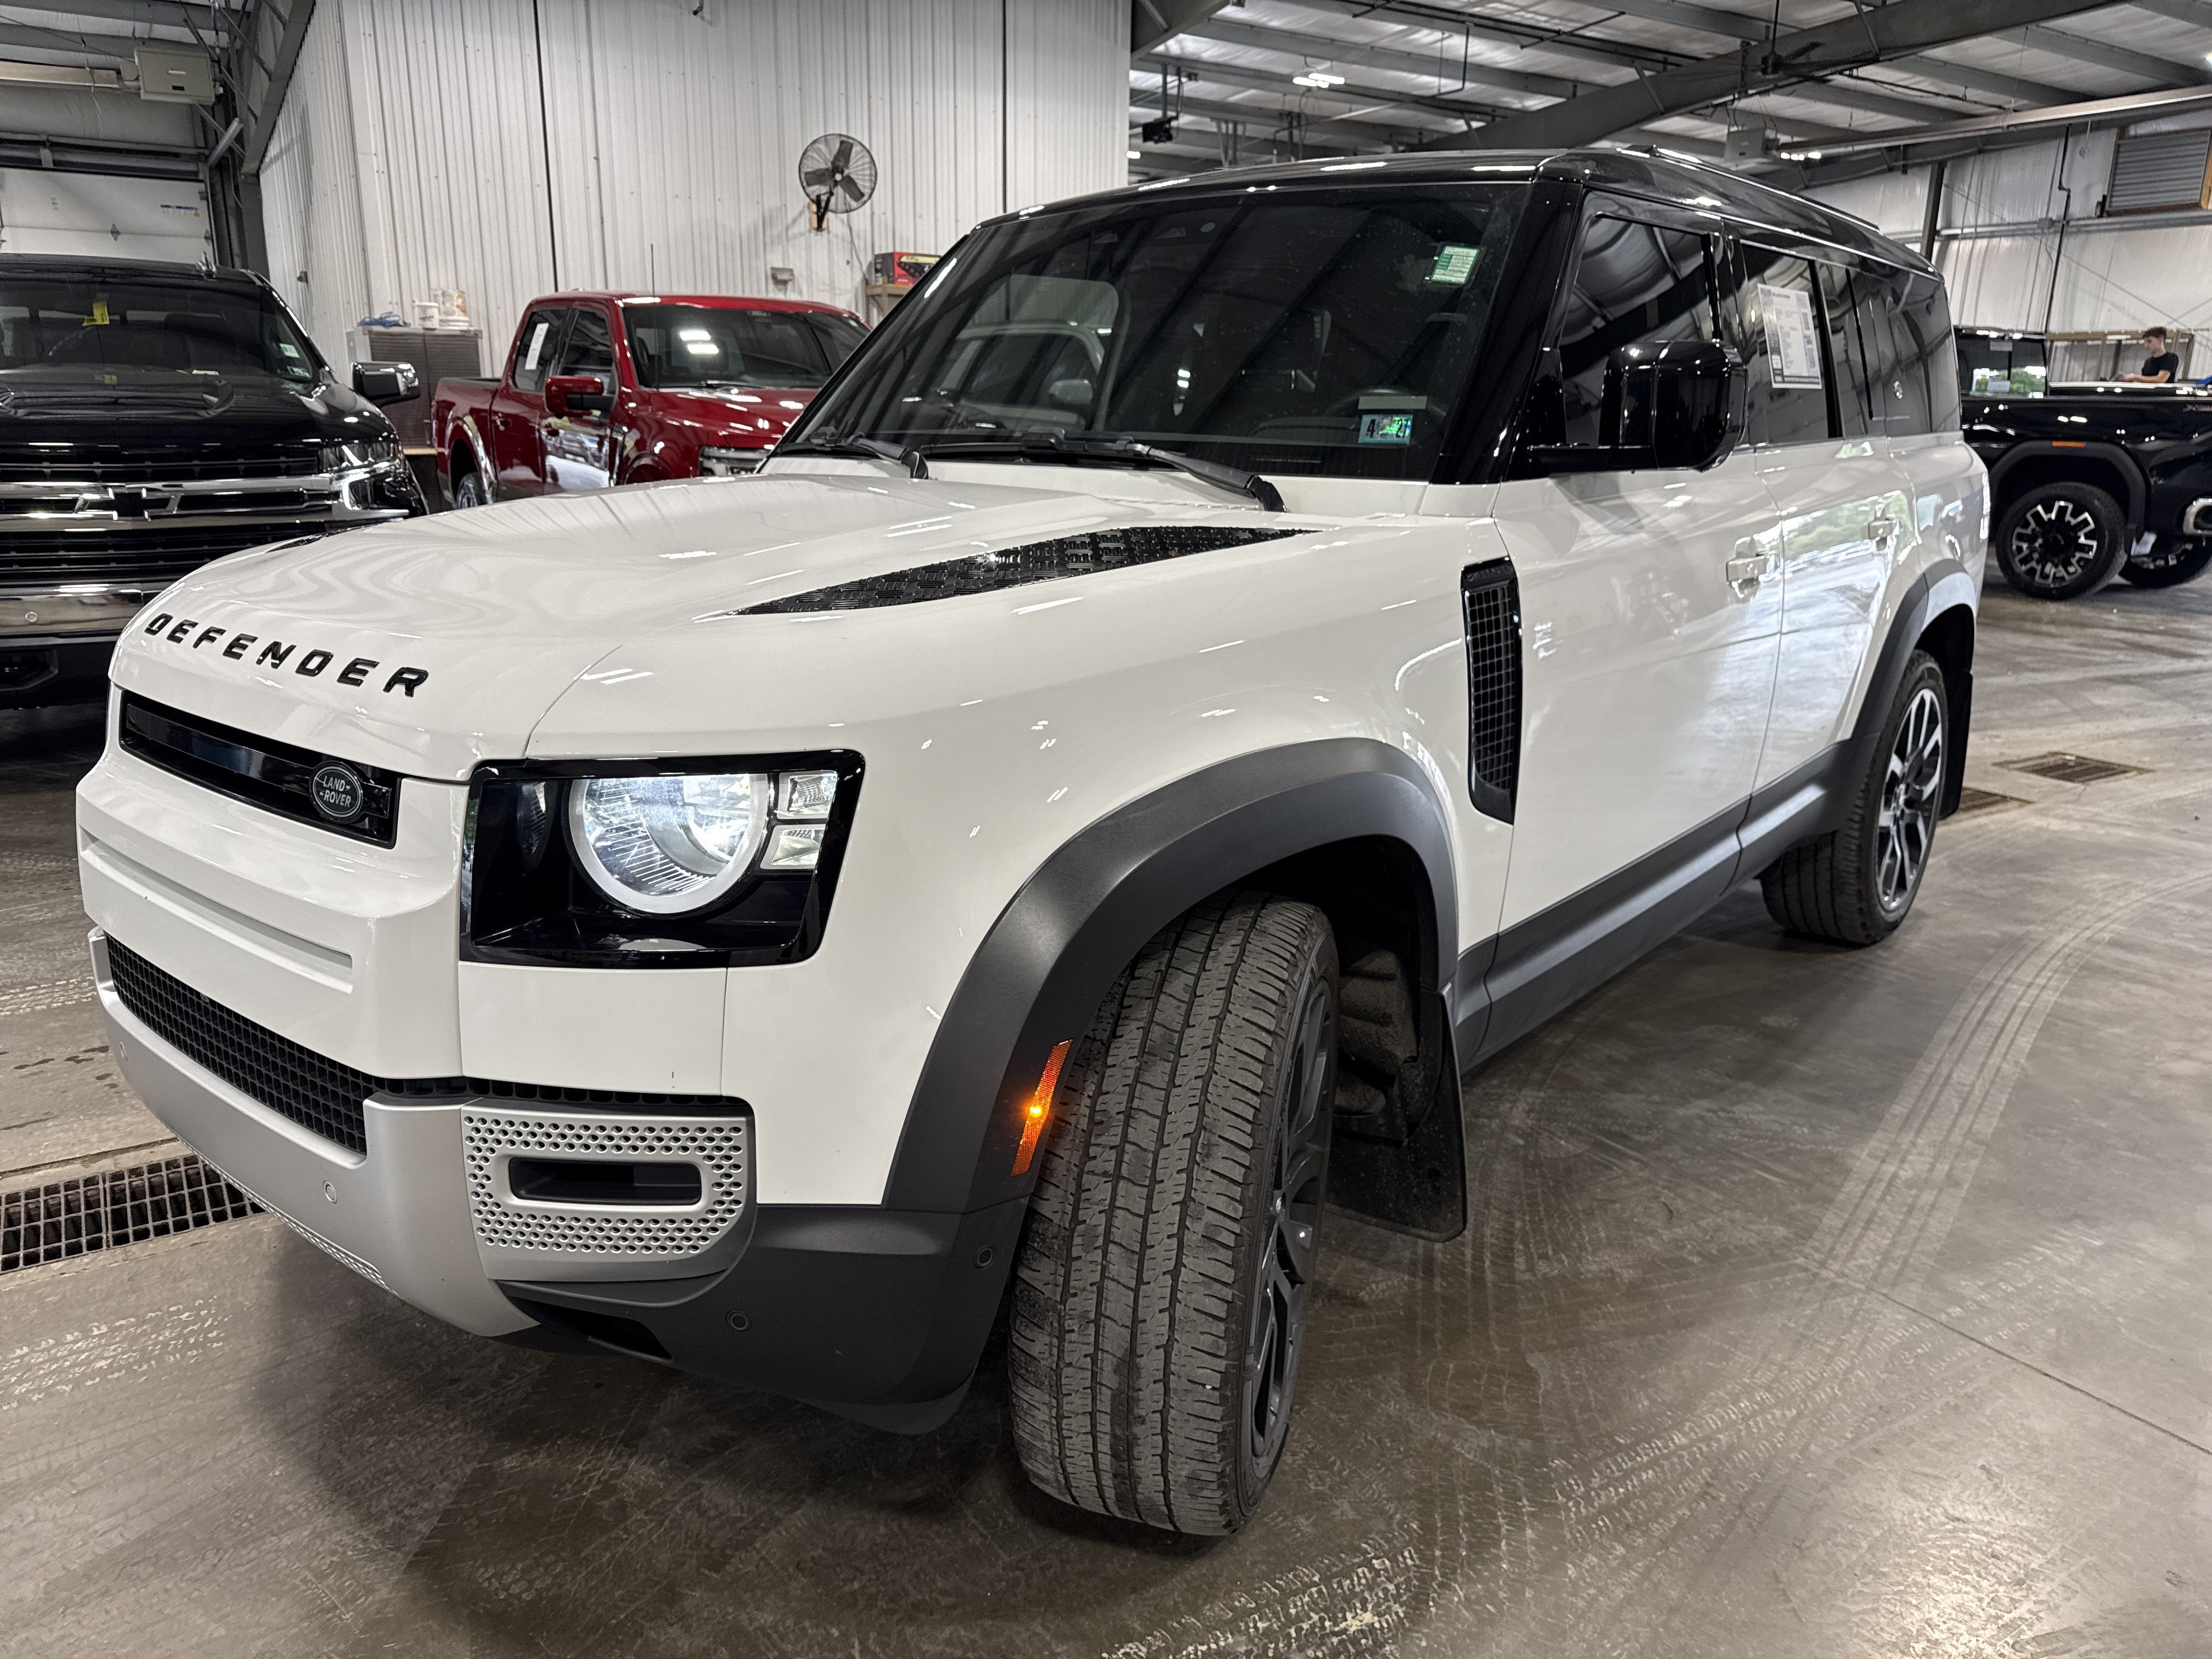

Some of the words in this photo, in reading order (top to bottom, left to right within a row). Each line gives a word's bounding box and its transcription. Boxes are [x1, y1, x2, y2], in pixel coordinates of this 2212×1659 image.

[1366, 419, 1376, 438] 4
[1396, 419, 1409, 439] 27
[144, 612, 430, 698] DEFENDER
